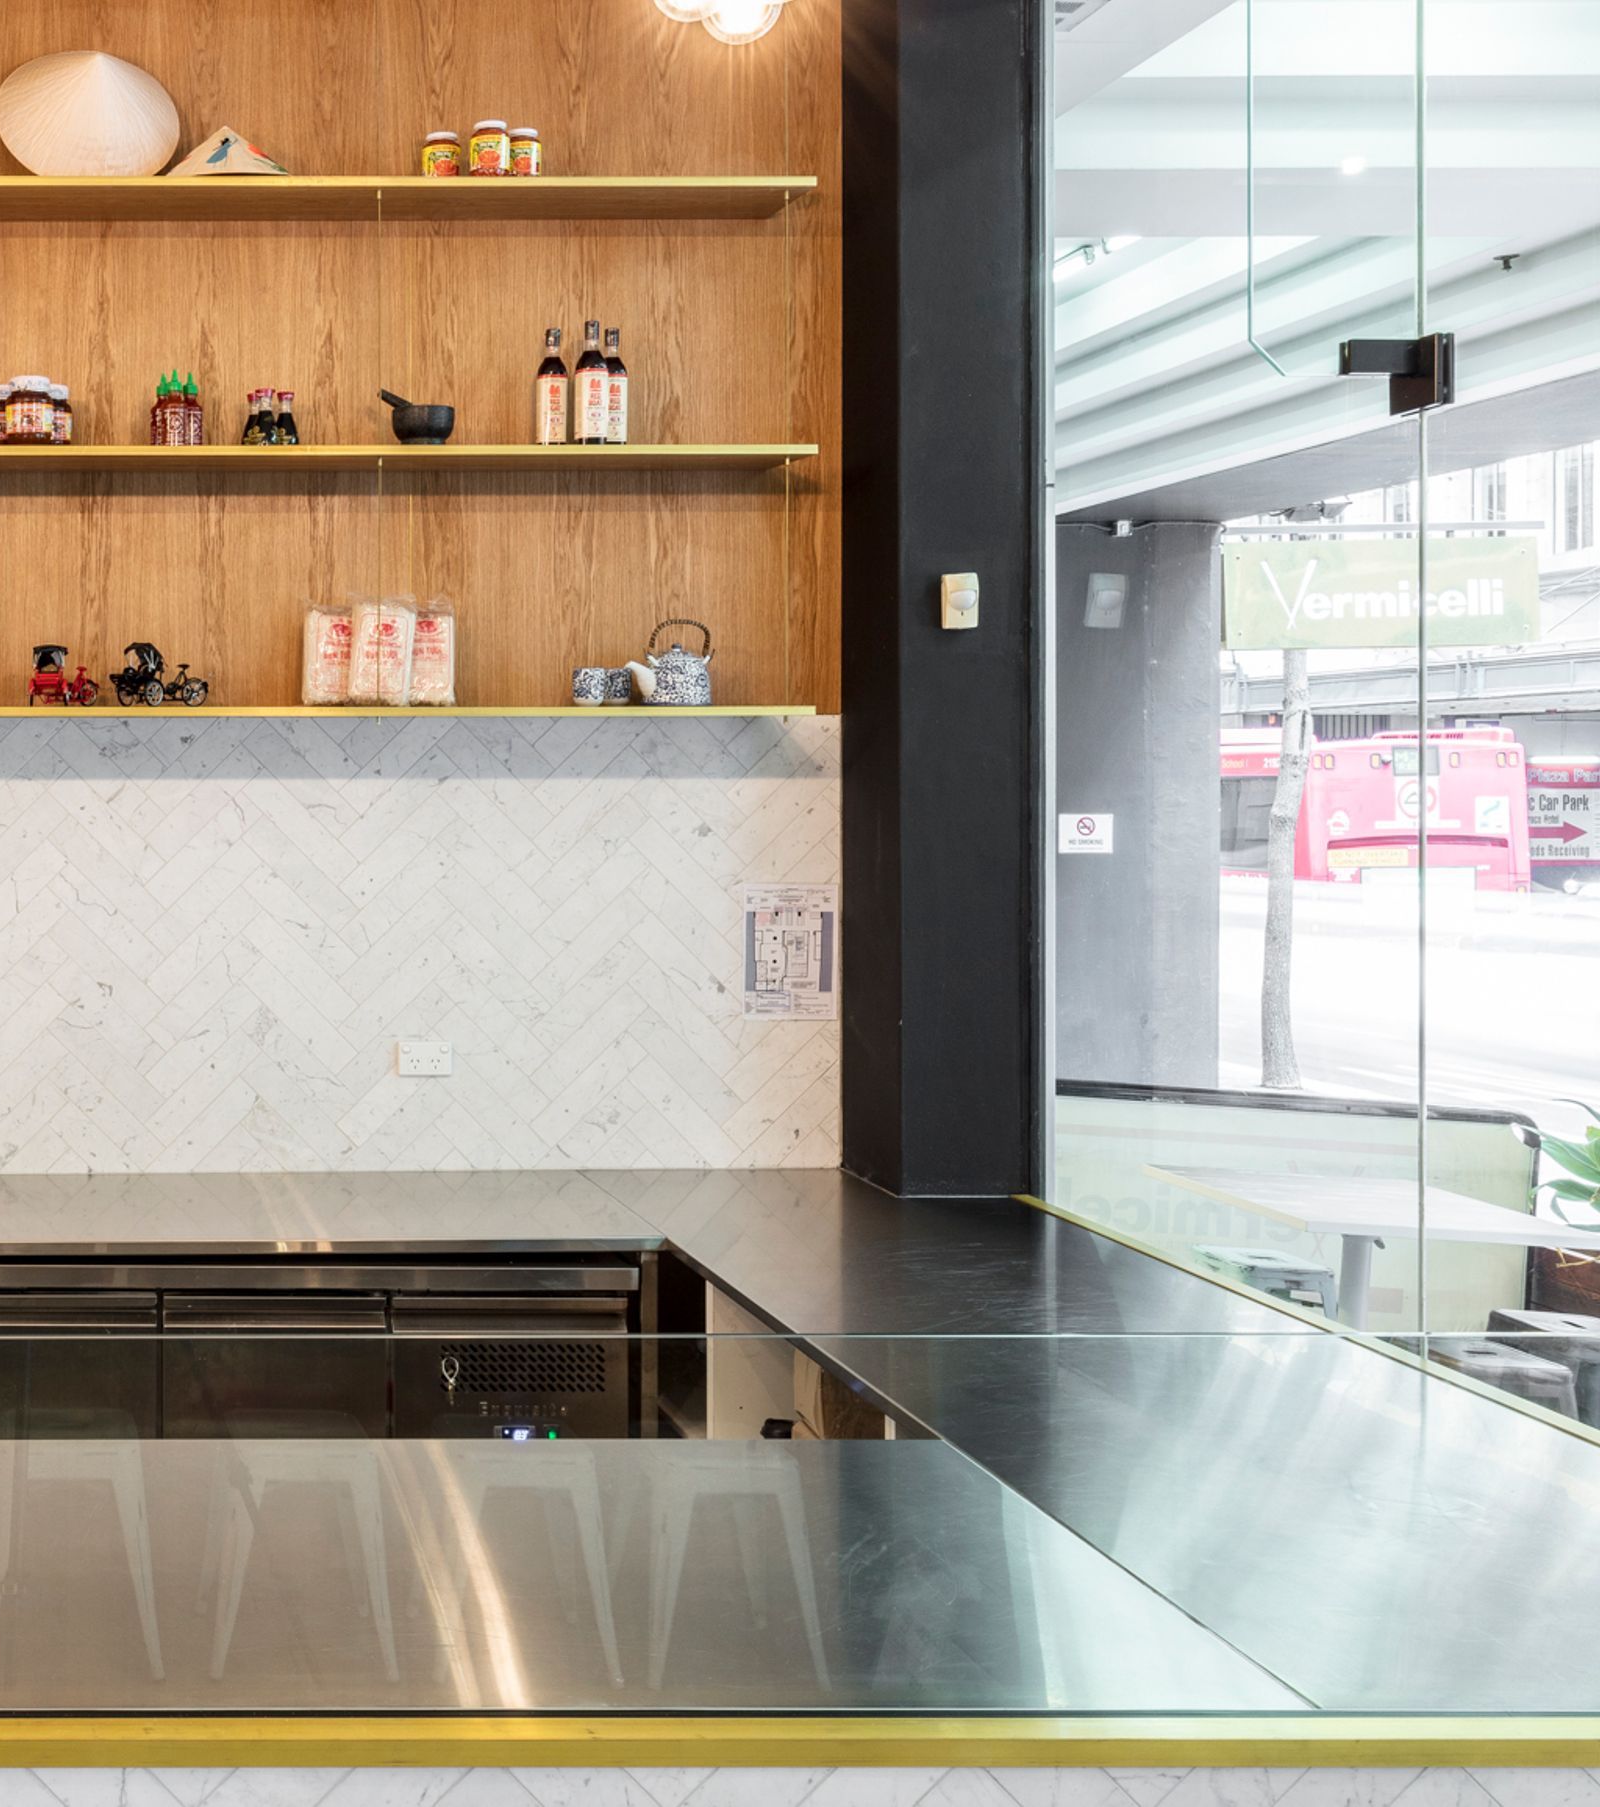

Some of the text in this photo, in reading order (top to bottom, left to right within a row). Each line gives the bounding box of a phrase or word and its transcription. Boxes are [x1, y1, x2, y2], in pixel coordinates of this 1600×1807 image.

[1260, 559, 1504, 630] Vermicelli
[1539, 794, 1560, 811] Car
[1562, 794, 1590, 811] Park
[1547, 845, 1591, 858] Receiving
